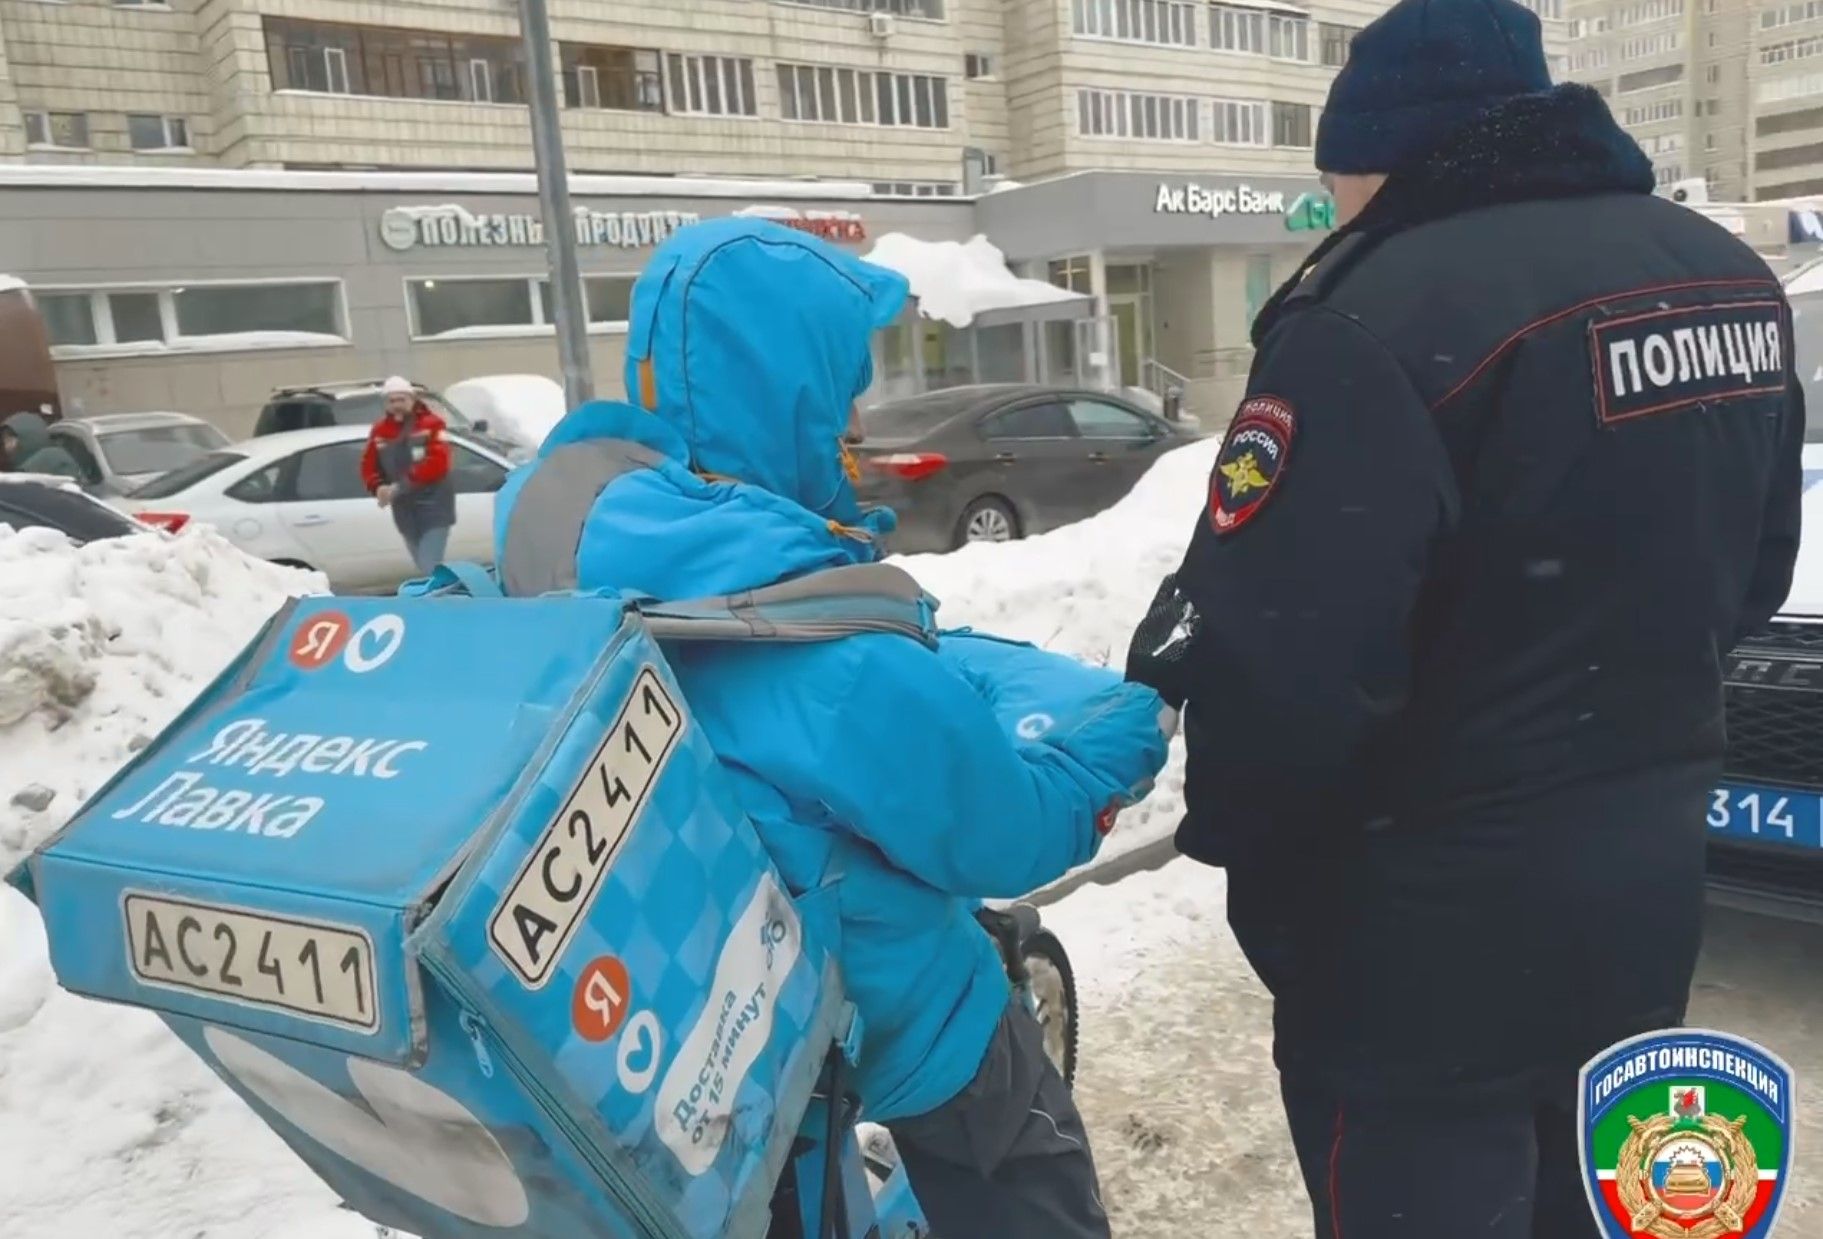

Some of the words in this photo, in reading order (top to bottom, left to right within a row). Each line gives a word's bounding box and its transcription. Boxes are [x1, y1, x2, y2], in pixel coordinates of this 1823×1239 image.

[1156, 183, 1185, 212] Ак
[1187, 183, 1236, 218] Барс
[1238, 184, 1284, 213] Банк
[1609, 321, 1782, 397] ПОЛИЦИЯ
[1232, 430, 1279, 460] РОССИЯ
[296, 620, 341, 661] Я
[186, 718, 429, 779] Яндекс
[111, 770, 325, 838] Лавка
[583, 969, 622, 1027] Я
[672, 989, 738, 1132] Доставка
[691, 1109, 712, 1145] от
[707, 1075, 725, 1106] 15
[721, 982, 767, 1071] минут
